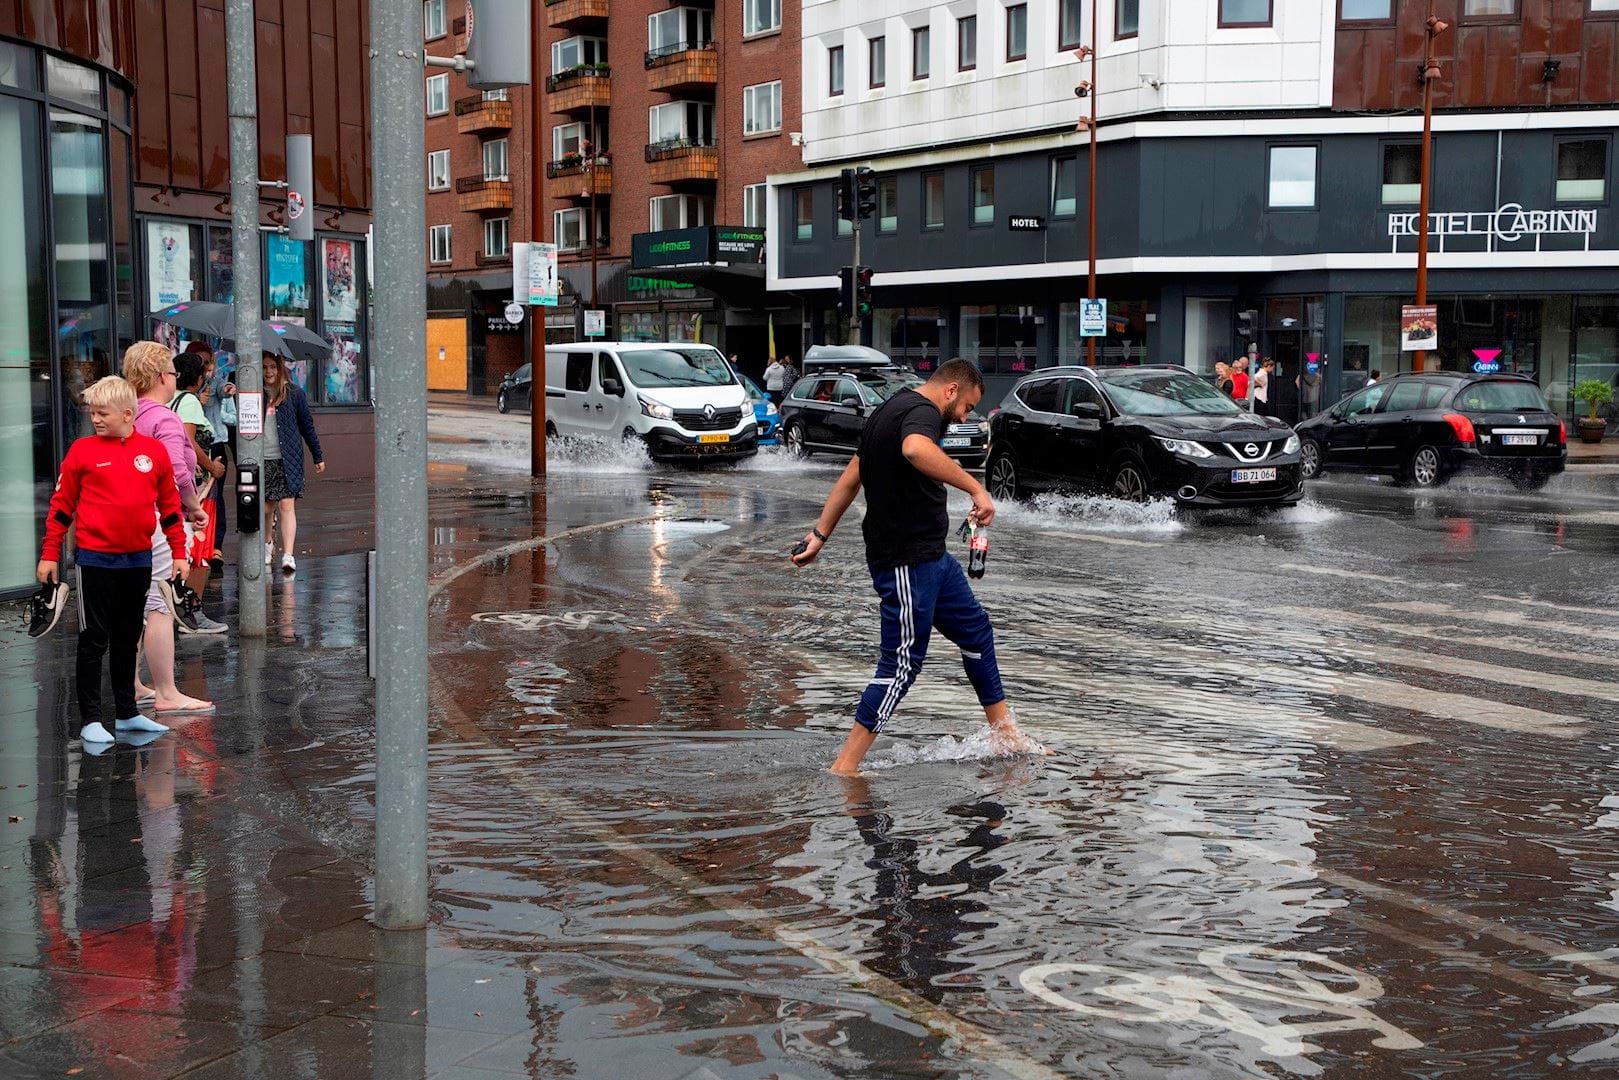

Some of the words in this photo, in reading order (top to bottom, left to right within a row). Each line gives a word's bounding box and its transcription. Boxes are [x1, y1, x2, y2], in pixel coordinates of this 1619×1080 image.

[1011, 219, 1040, 228] HOTEL
[1388, 213, 1482, 236] HOTEL
[1493, 203, 1598, 242] CABINN
[1237, 472, 1248, 481] BB
[1250, 471, 1259, 480] 71
[1260, 470, 1275, 480] 064
